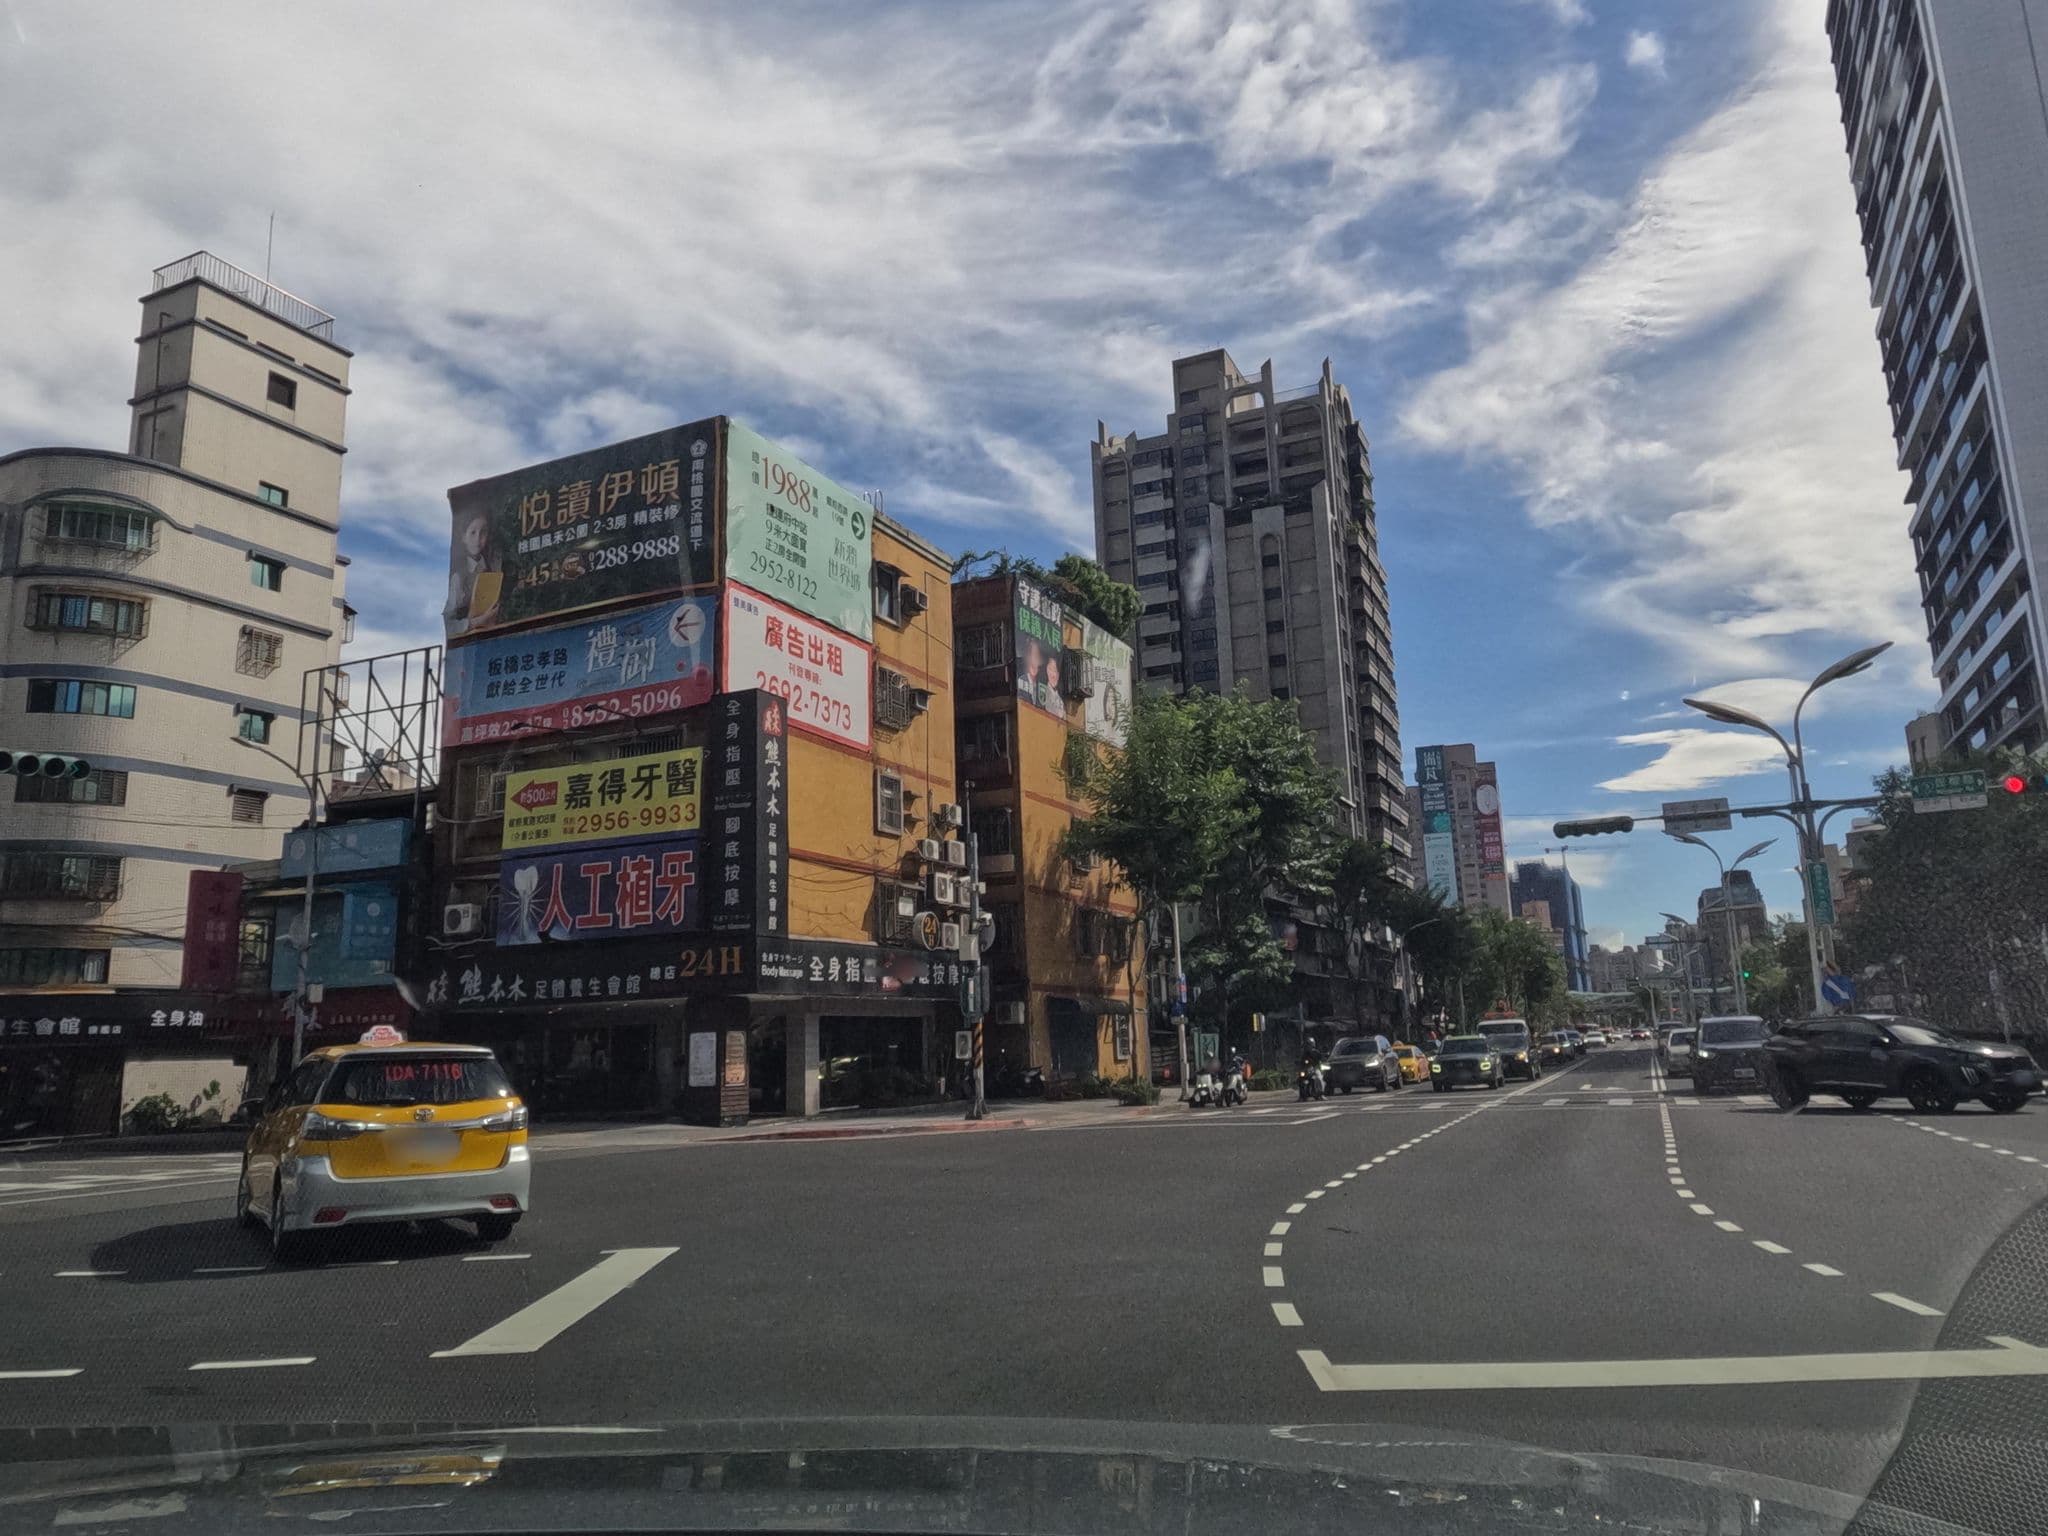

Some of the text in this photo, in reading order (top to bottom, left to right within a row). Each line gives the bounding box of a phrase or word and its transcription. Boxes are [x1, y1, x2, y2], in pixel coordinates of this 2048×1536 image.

[762, 456, 812, 514] 1988
[593, 514, 627, 534] 2-3房
[633, 504, 681, 527] 精裝修
[690, 458, 705, 551] 南桃園交流道下
[595, 536, 681, 571] 288-9888
[750, 550, 818, 600] 2952-8122
[487, 647, 569, 678] 板橋忠孝路
[764, 615, 844, 677] 廣告出租
[486, 670, 567, 699] 獻給全世代
[571, 686, 683, 728] 8952-5096
[725, 698, 741, 786] 全身指壓
[564, 757, 697, 811] 嘉得牙醫
[577, 802, 697, 834] 2956-9933
[724, 816, 741, 907] 腳底按摩
[538, 850, 694, 931] 人工植牙
[924, 917, 937, 934] 24
[681, 944, 744, 977] 24H
[761, 964, 778, 978] Body
[150, 1009, 204, 1028] 全身油
